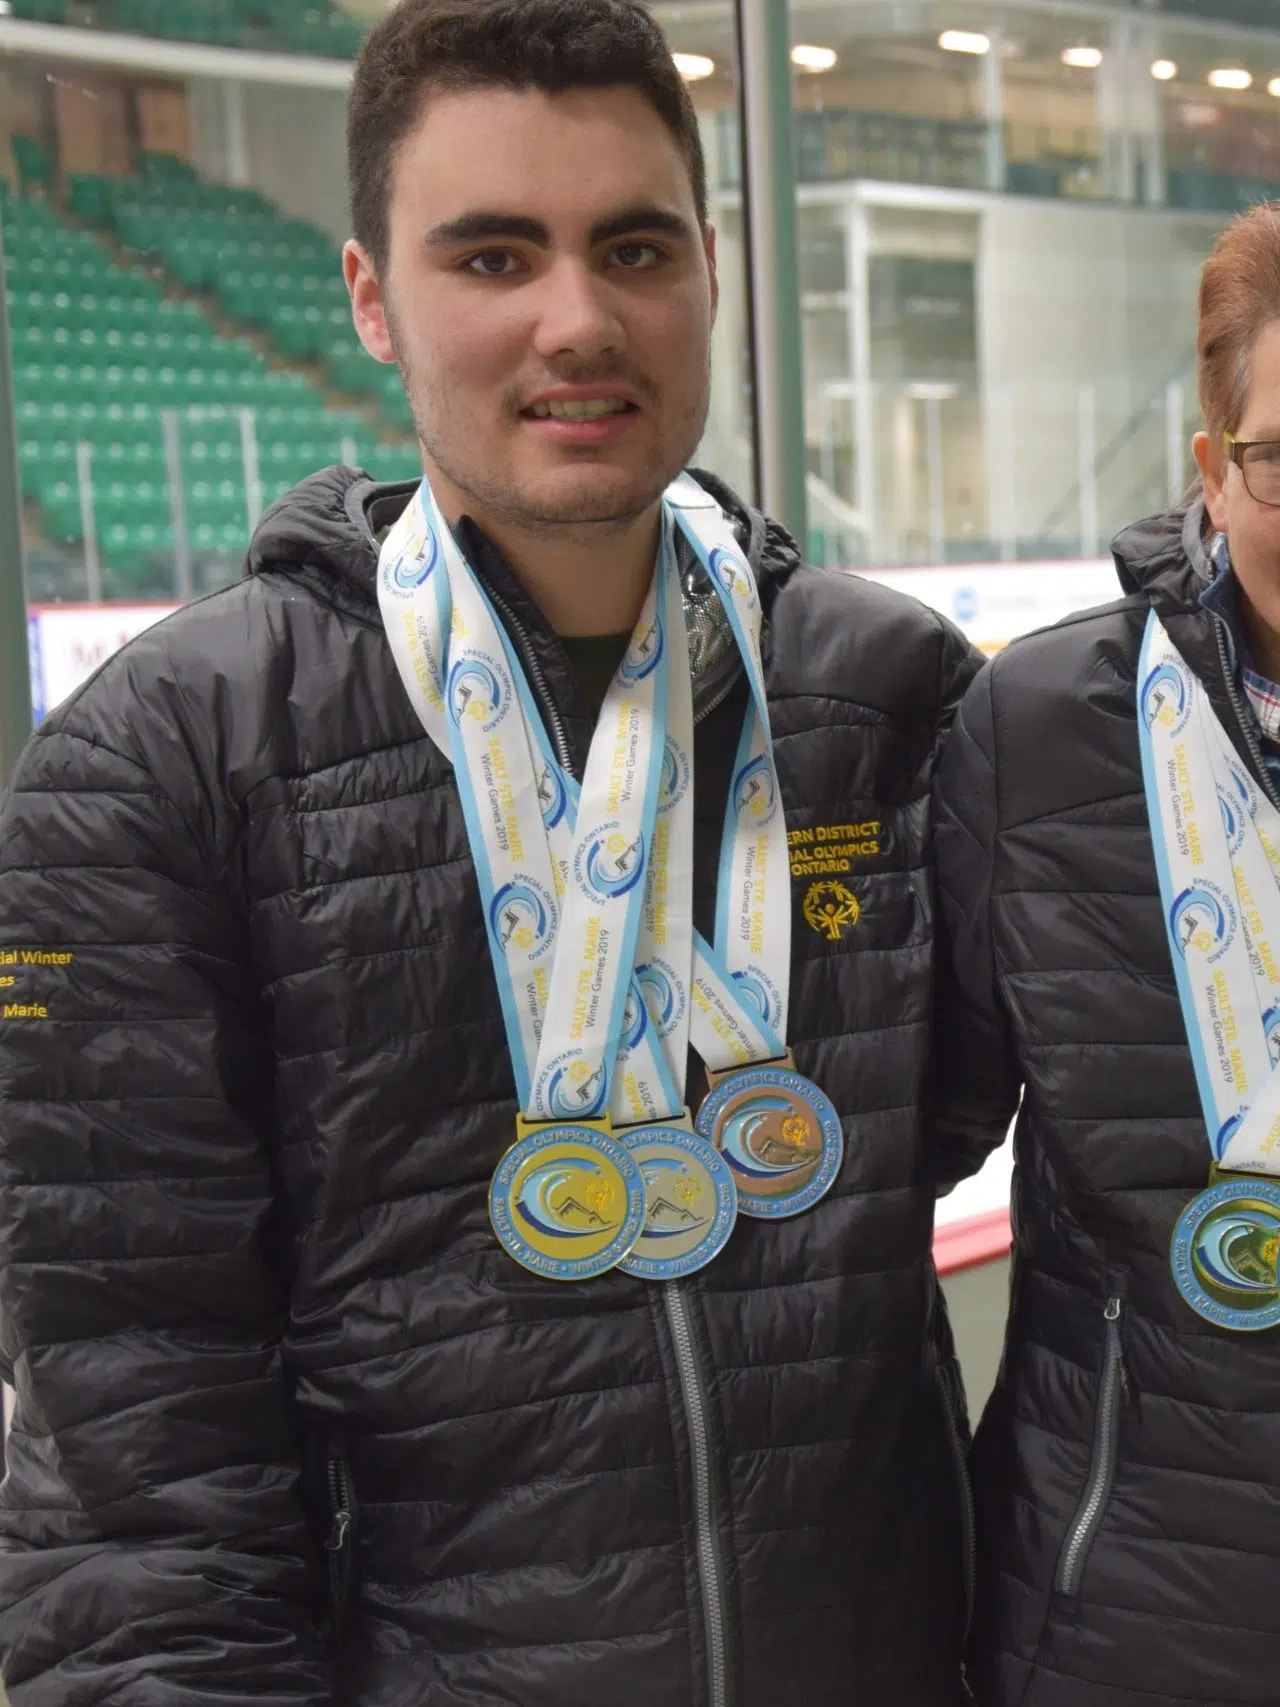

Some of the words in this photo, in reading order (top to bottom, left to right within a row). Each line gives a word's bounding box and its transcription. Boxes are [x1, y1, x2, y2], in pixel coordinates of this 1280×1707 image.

[630, 708, 639, 732] 2019
[488, 739, 508, 779] SAULT
[626, 734, 638, 768] Games
[605, 773, 622, 813] SAULT
[622, 770, 635, 802] Winter
[481, 753, 494, 787] Winter
[488, 789, 501, 822] Games
[496, 826, 509, 851] 2019
[1168, 759, 1176, 792] Winter
[1172, 794, 1182, 830] Games
[1177, 831, 1189, 856] 2019
[817, 821, 880, 842] DISTRICT
[573, 842, 588, 883] OLYMPICS
[584, 821, 620, 843] ONTARIO
[745, 846, 756, 878] Winter
[814, 841, 879, 858] OLYMPICS
[513, 873, 543, 892] SPECIAL
[791, 859, 850, 876] ONTARIO
[742, 880, 754, 914] Games
[1193, 878, 1222, 896] SPECIAL
[543, 891, 557, 930] OLYMPICS
[1222, 894, 1237, 933] OLYMPICS
[740, 916, 751, 941] 2019
[21, 952, 73, 965] Winter
[528, 931, 555, 960] ONTARIO
[1207, 934, 1234, 964] ONTARIO
[585, 994, 599, 1028] Winter
[592, 958, 606, 992] Games
[600, 929, 609, 956] 2019
[1250, 952, 1265, 976] 2019
[526, 983, 538, 1018] Winter
[652, 956, 677, 980] SPECIAL
[675, 981, 687, 1023] OLYMPICS
[696, 978, 715, 999] 2019
[3, 1003, 47, 1018] Marie
[569, 996, 589, 1040] SAULT
[1206, 984, 1218, 1018] Winter
[1212, 1020, 1226, 1056] Games
[1220, 1059, 1233, 1083] 2019
[547, 1048, 582, 1071] ONTARIO
[638, 1081, 652, 1106] 2019
[523, 1251, 560, 1273] MARIE
